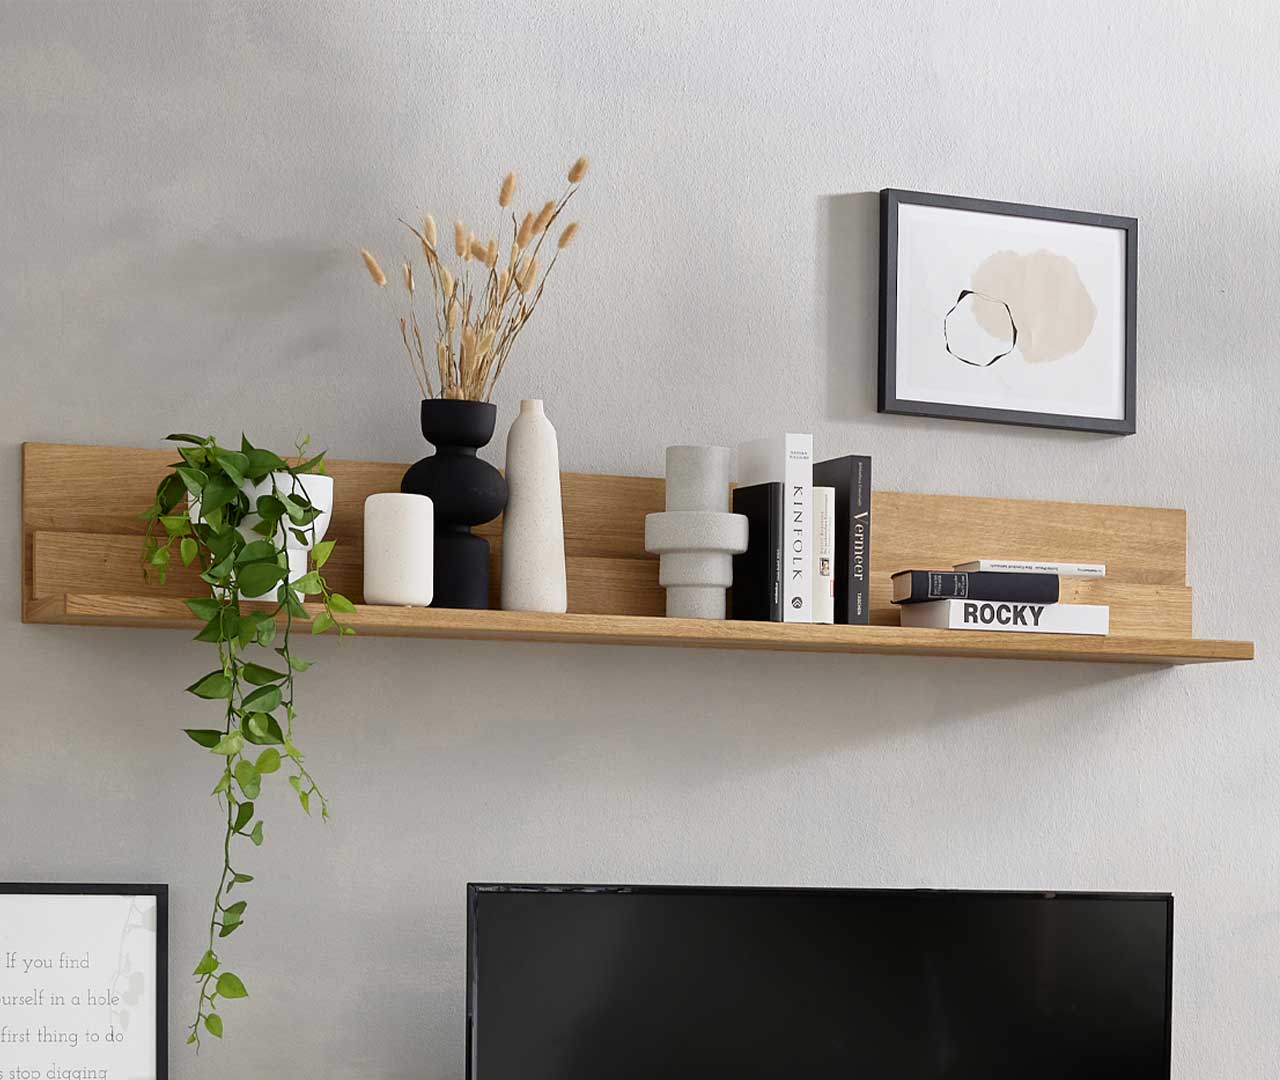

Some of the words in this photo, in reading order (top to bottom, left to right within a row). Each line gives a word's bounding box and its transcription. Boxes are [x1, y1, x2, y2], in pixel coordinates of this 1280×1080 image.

[793, 486, 803, 580] KINFOLK
[854, 512, 869, 581] Vermeer
[963, 603, 1045, 627] ROCKY
[5, 952, 16, 969] If
[23, 958, 53, 973] you
[59, 952, 90, 969] find
[50, 990, 66, 1006] in
[71, 994, 81, 1006] a
[87, 989, 120, 1006] hole
[1, 1026, 31, 1043] first
[37, 1026, 79, 1047] thing
[86, 1029, 100, 1043] to
[105, 1026, 124, 1043] do
